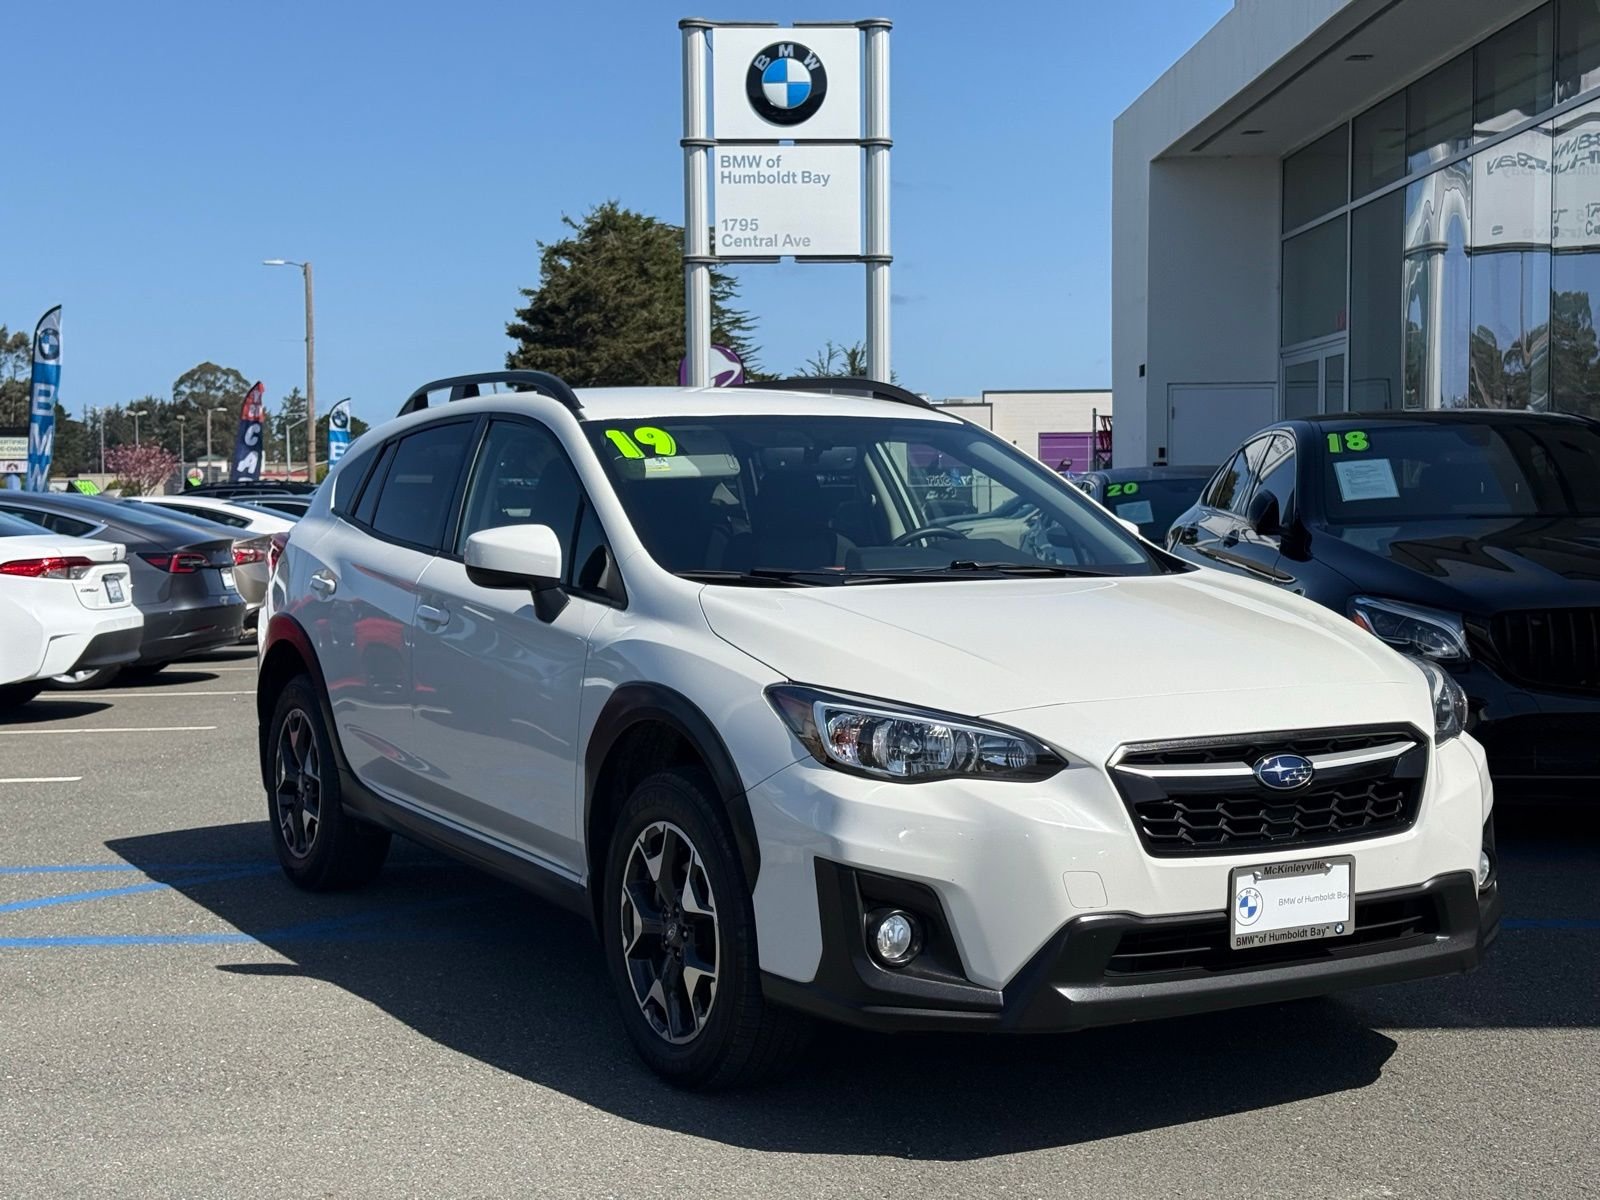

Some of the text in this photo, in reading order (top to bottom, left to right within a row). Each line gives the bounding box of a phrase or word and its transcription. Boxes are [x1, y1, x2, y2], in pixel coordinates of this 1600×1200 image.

[754, 44, 820, 71] BMW
[720, 154, 782, 168] BMW of
[720, 170, 830, 187] Humboldt Bay
[721, 218, 759, 231] 1795
[721, 233, 811, 248] Central Ave
[28, 382, 55, 492] BMW
[605, 426, 677, 459] 19
[1326, 431, 1370, 453] 18
[237, 422, 261, 481] CA
[1106, 482, 1139, 497] 20
[1263, 861, 1326, 876] McKinleyville
[1278, 896, 1296, 906] BMW
[1296, 895, 1304, 904] of
[1304, 892, 1336, 903] Humboldt
[1258, 933, 1267, 944] of
[1268, 928, 1308, 942] Humboldt
